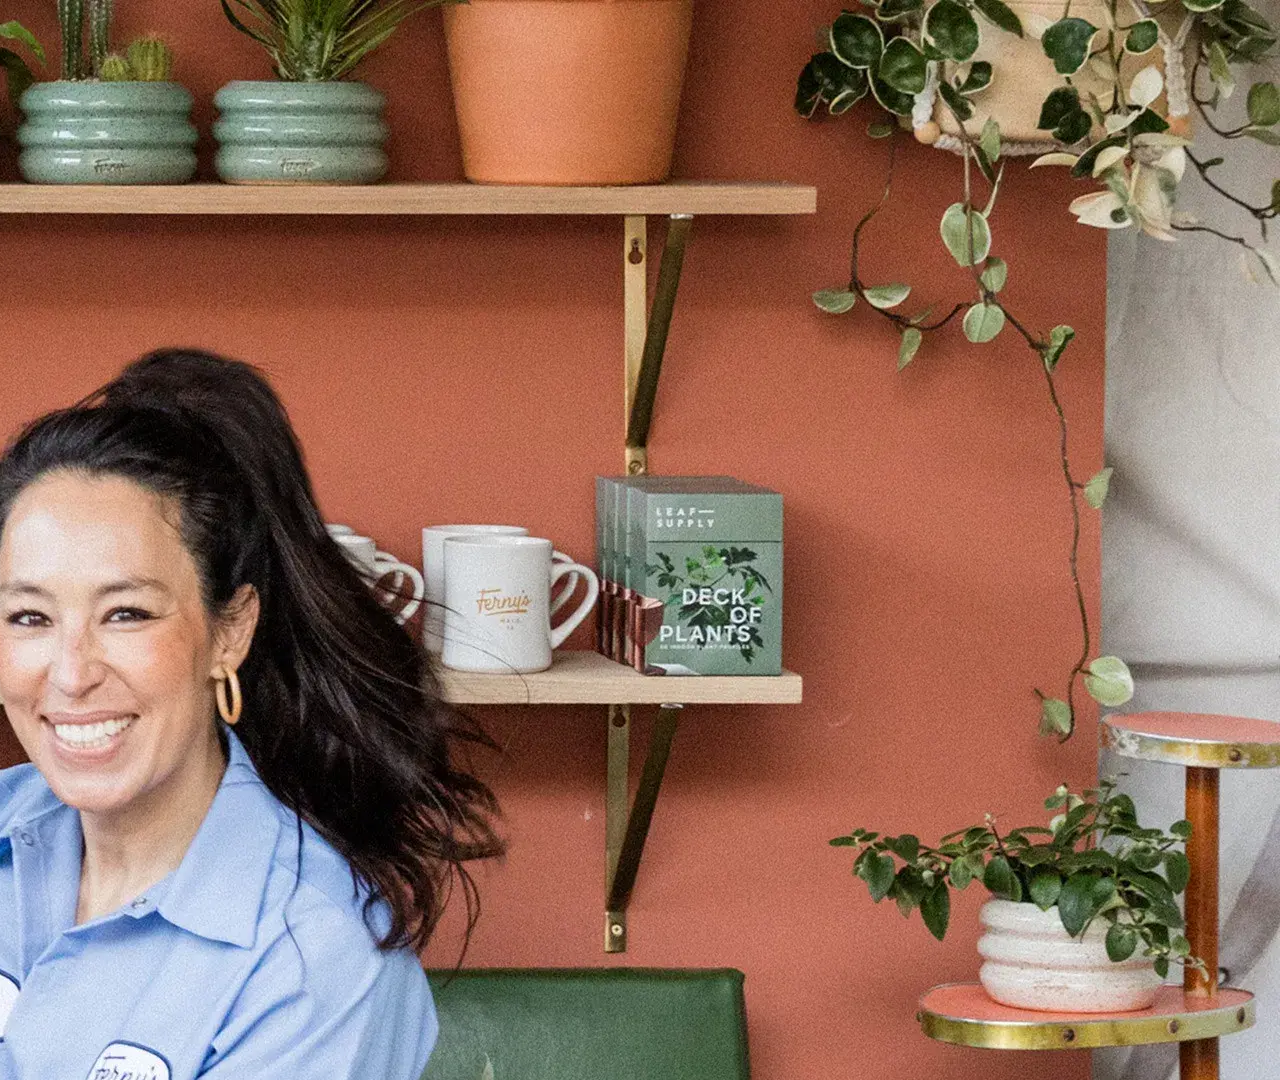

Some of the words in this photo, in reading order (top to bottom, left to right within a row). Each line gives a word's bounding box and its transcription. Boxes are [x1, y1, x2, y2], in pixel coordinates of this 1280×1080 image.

[656, 519, 715, 528] SUPPLY
[682, 588, 745, 605] DECK
[730, 606, 762, 624] OF
[660, 625, 751, 642] PLANTS
